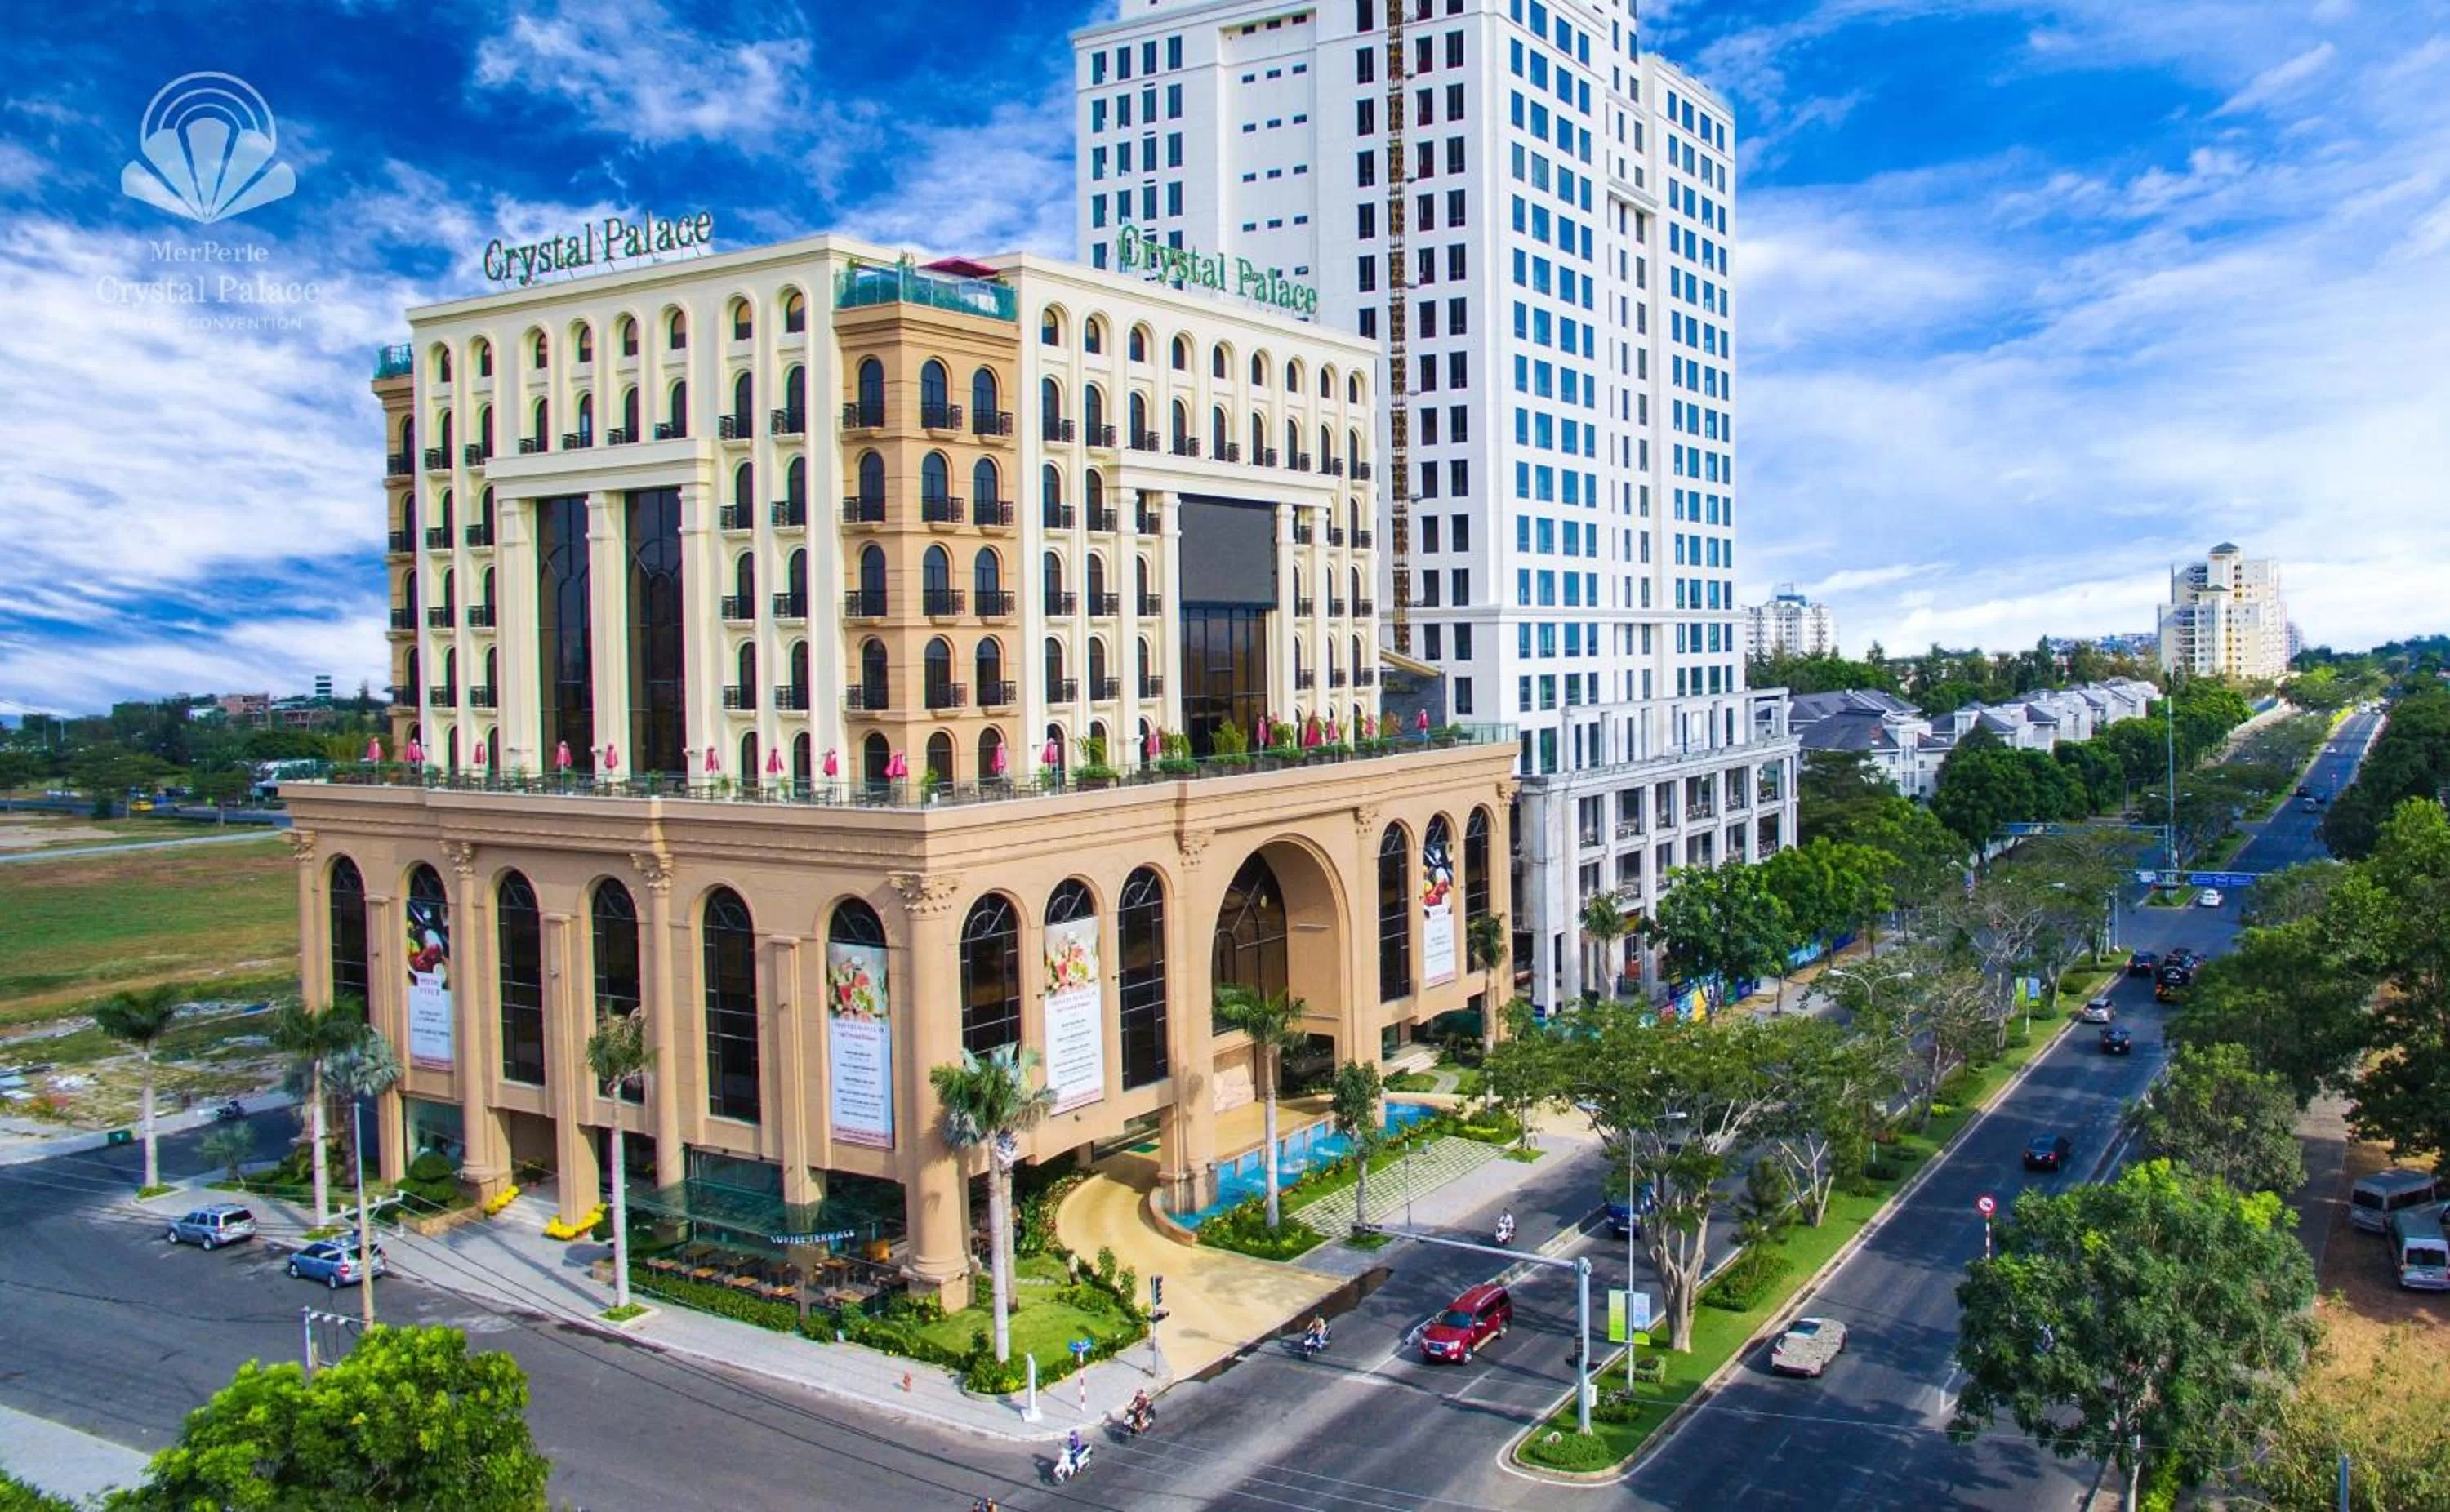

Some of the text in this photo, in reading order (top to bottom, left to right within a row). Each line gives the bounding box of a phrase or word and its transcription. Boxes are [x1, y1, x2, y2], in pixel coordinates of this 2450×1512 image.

[483, 211, 713, 287] Crystal Palace
[1117, 224, 1318, 314] Crystal Palace
